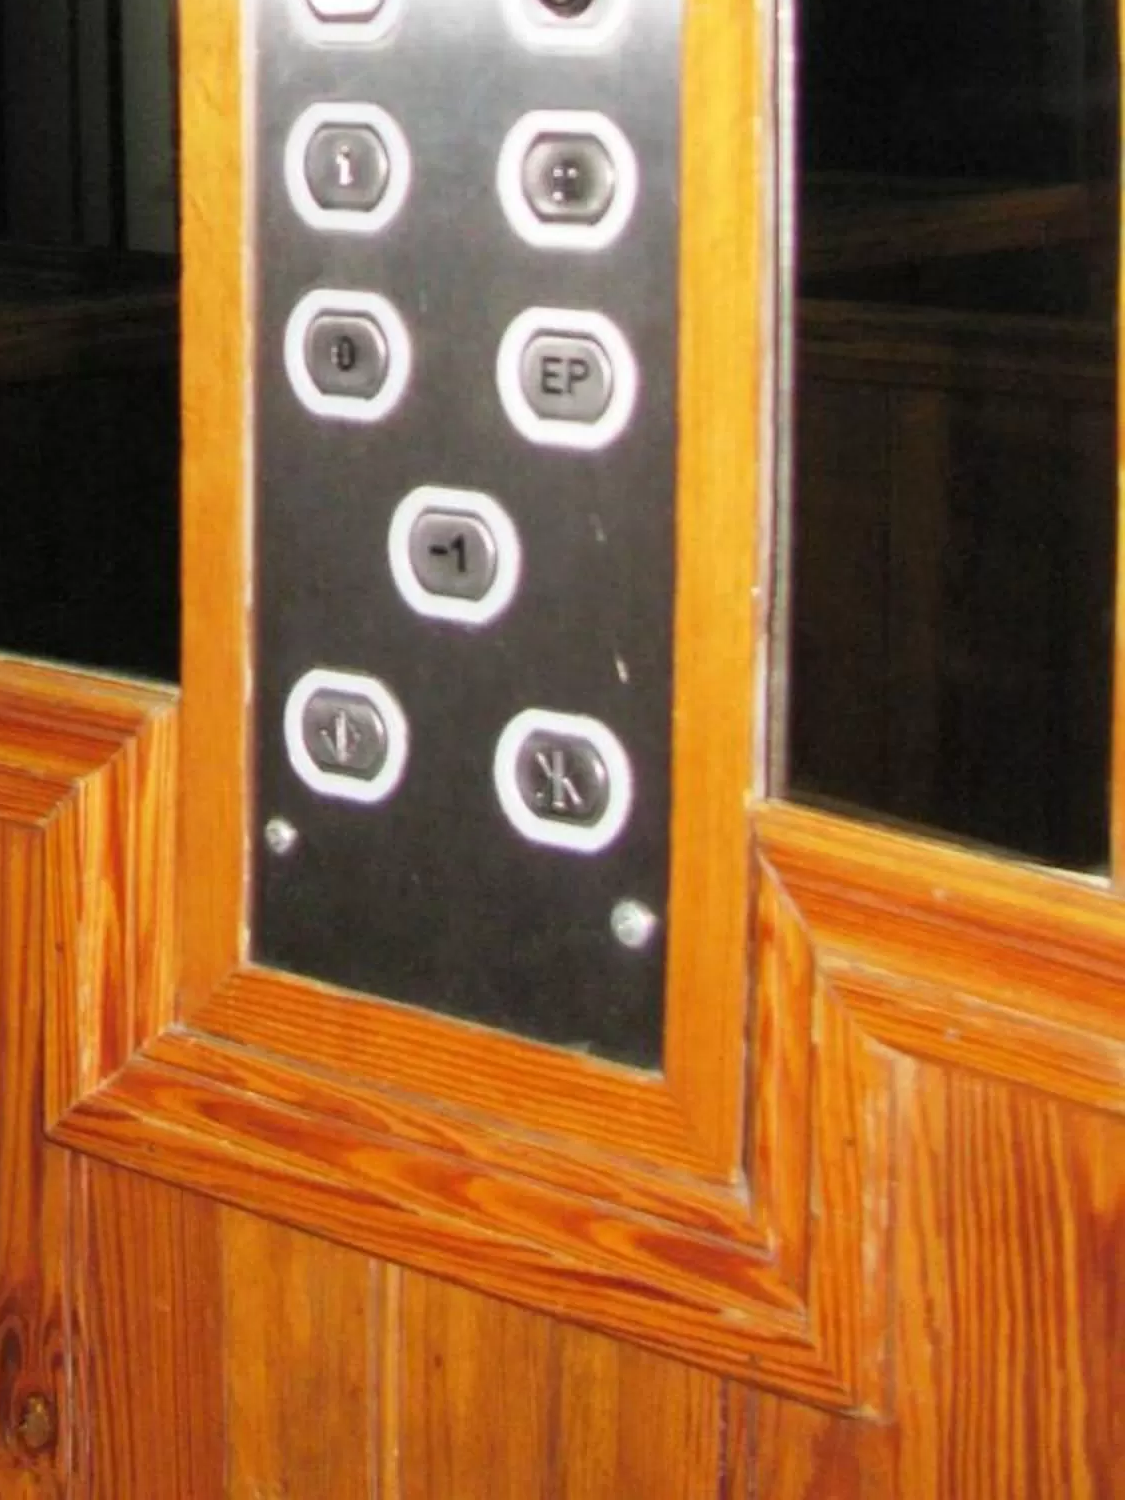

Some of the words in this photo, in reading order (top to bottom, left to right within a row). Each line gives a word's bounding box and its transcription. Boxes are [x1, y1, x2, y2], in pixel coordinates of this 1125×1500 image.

[334, 335, 357, 373] 0
[540, 356, 591, 396] EP
[429, 534, 467, 574] -1
